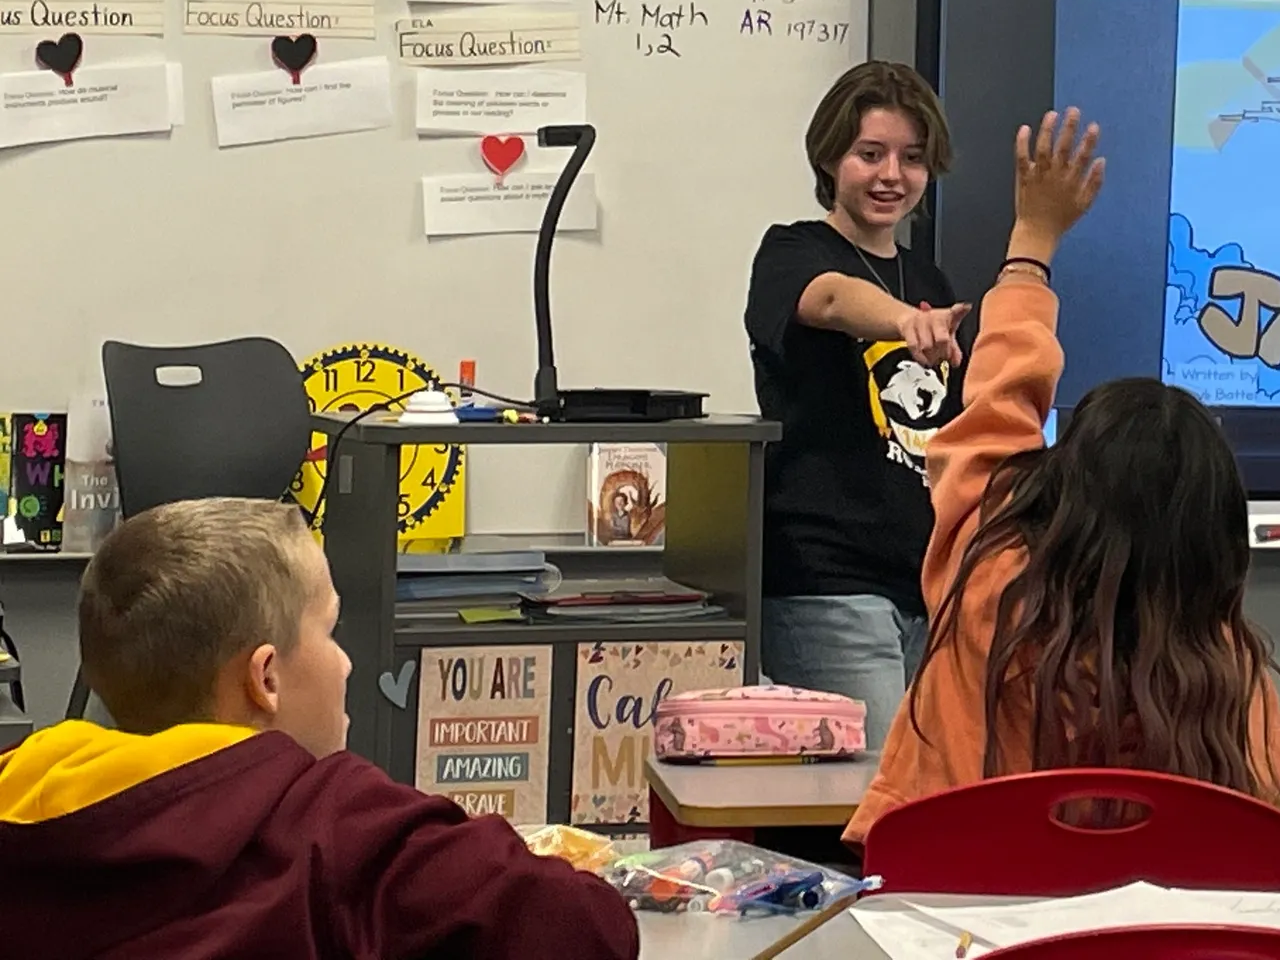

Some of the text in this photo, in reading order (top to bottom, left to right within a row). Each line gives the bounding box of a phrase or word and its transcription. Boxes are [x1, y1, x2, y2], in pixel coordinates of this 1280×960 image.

[31, 0, 134, 27] Question
[185, 0, 239, 28] Focus
[641, 2, 709, 30] Math
[740, 9, 773, 36] AR
[400, 31, 454, 59] Focus
[323, 361, 405, 393] 11 12 1
[1182, 368, 1236, 380] Written
[82, 474, 108, 487] The
[421, 468, 438, 491] 4
[438, 656, 536, 701] YOU ARE
[433, 719, 532, 744] IMPORTANT
[442, 756, 523, 780] AMAZING
[454, 793, 508, 816] BRAVE
